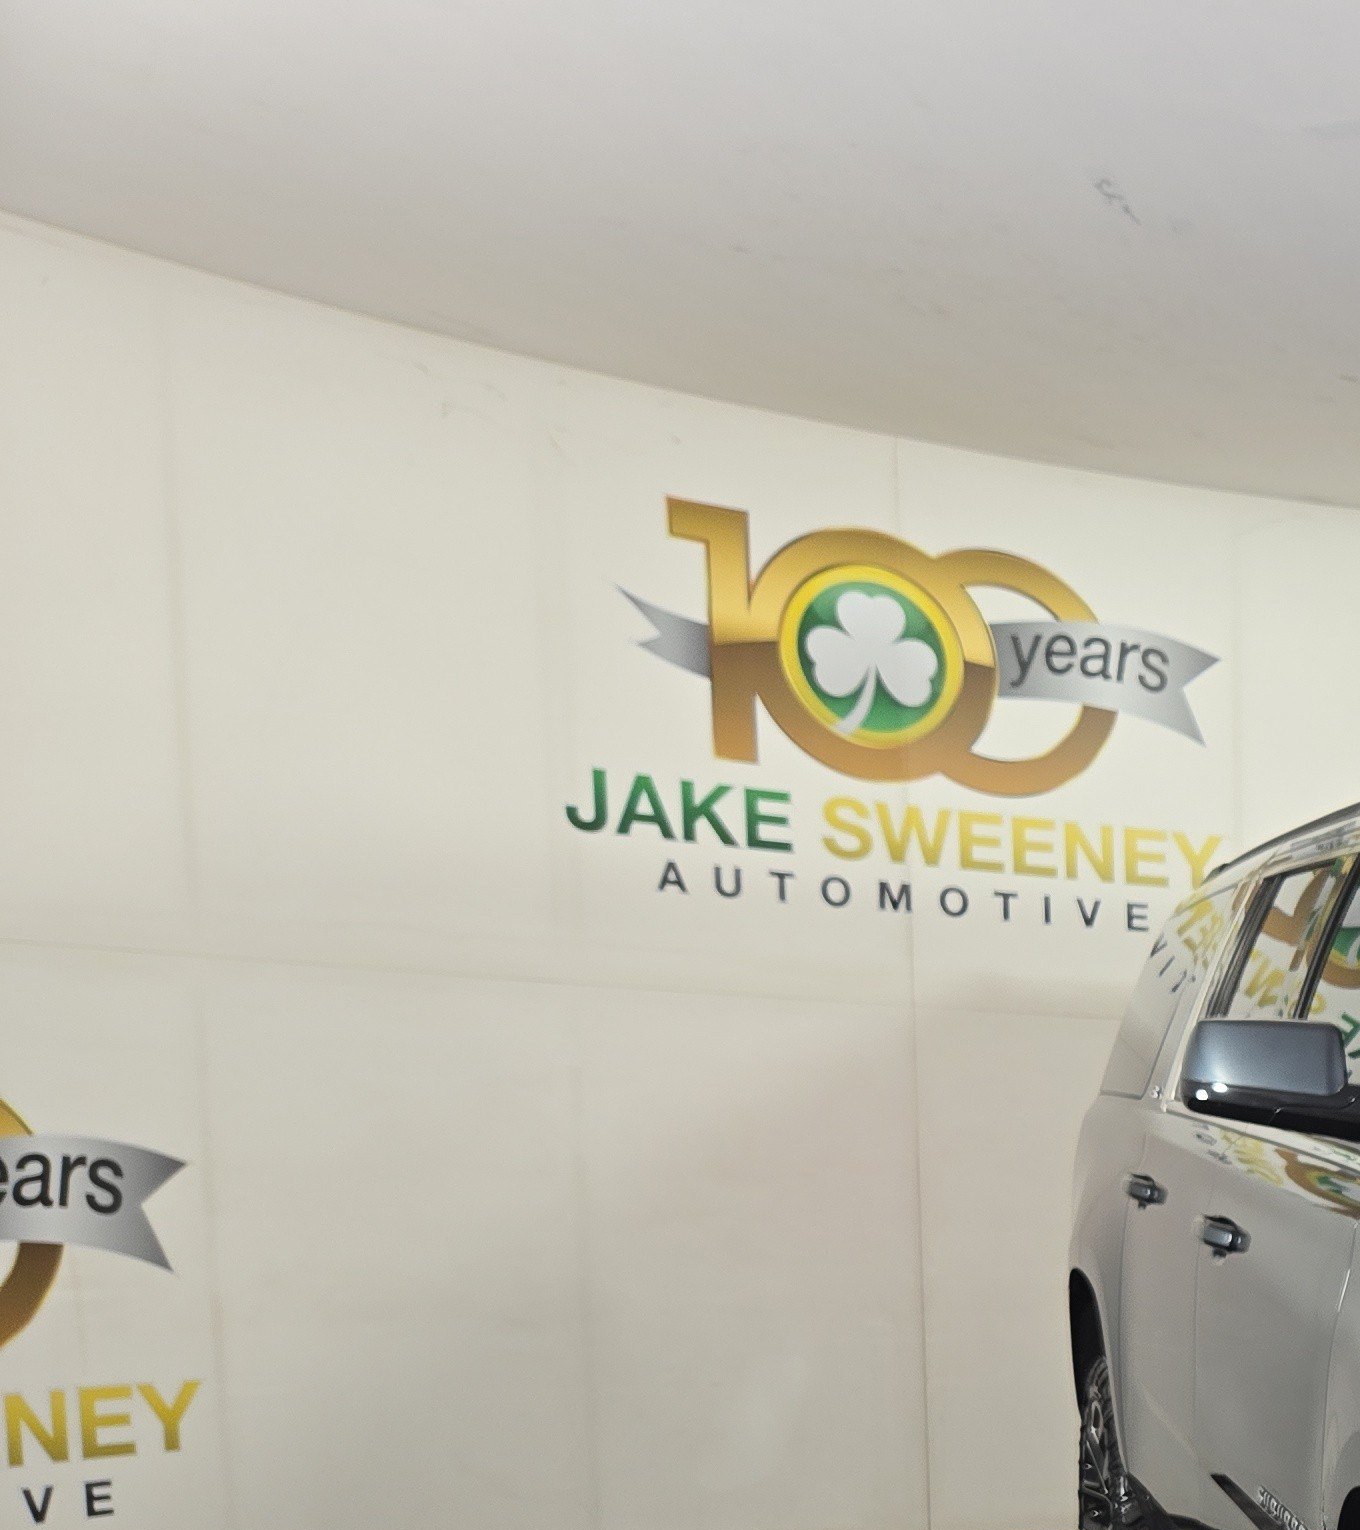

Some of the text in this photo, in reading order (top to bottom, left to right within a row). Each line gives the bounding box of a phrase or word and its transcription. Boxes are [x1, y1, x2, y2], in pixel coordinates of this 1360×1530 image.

[666, 495, 1170, 798] 100 years
[565, 767, 1223, 892] JAKE SWEENEY
[656, 861, 1149, 932] AUTOMOTIVE
[0, 1152, 125, 1216] ars
